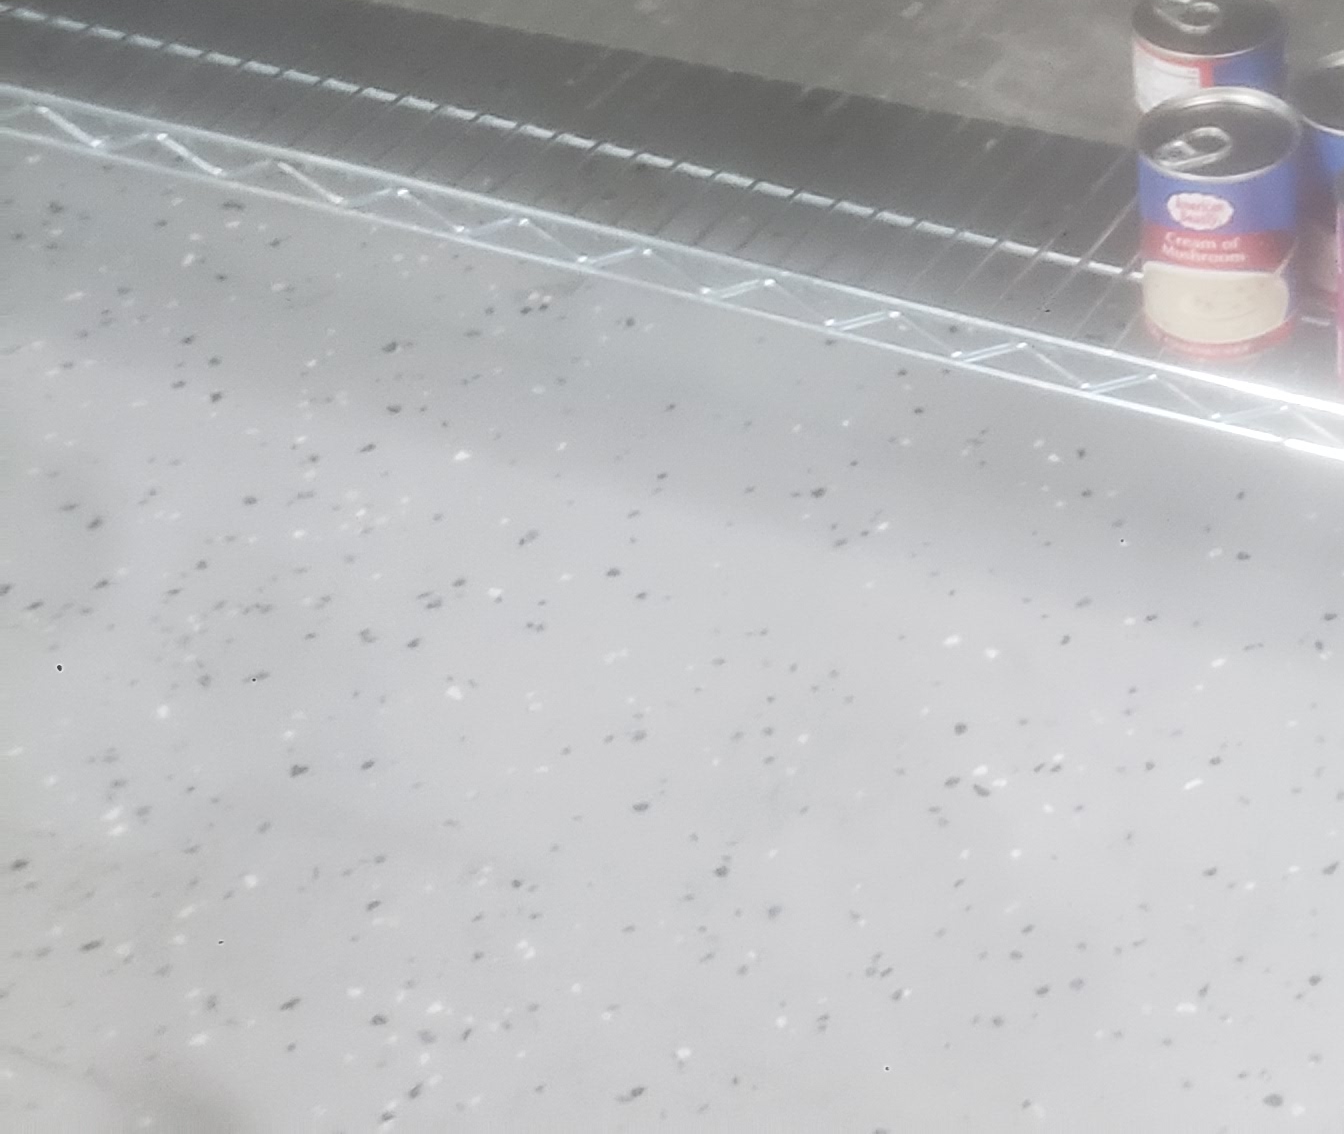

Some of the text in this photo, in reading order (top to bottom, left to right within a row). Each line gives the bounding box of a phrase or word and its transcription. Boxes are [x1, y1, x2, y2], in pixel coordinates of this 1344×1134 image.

[1164, 231, 1241, 250] Cream of
[1161, 242, 1247, 264] Mushroom
